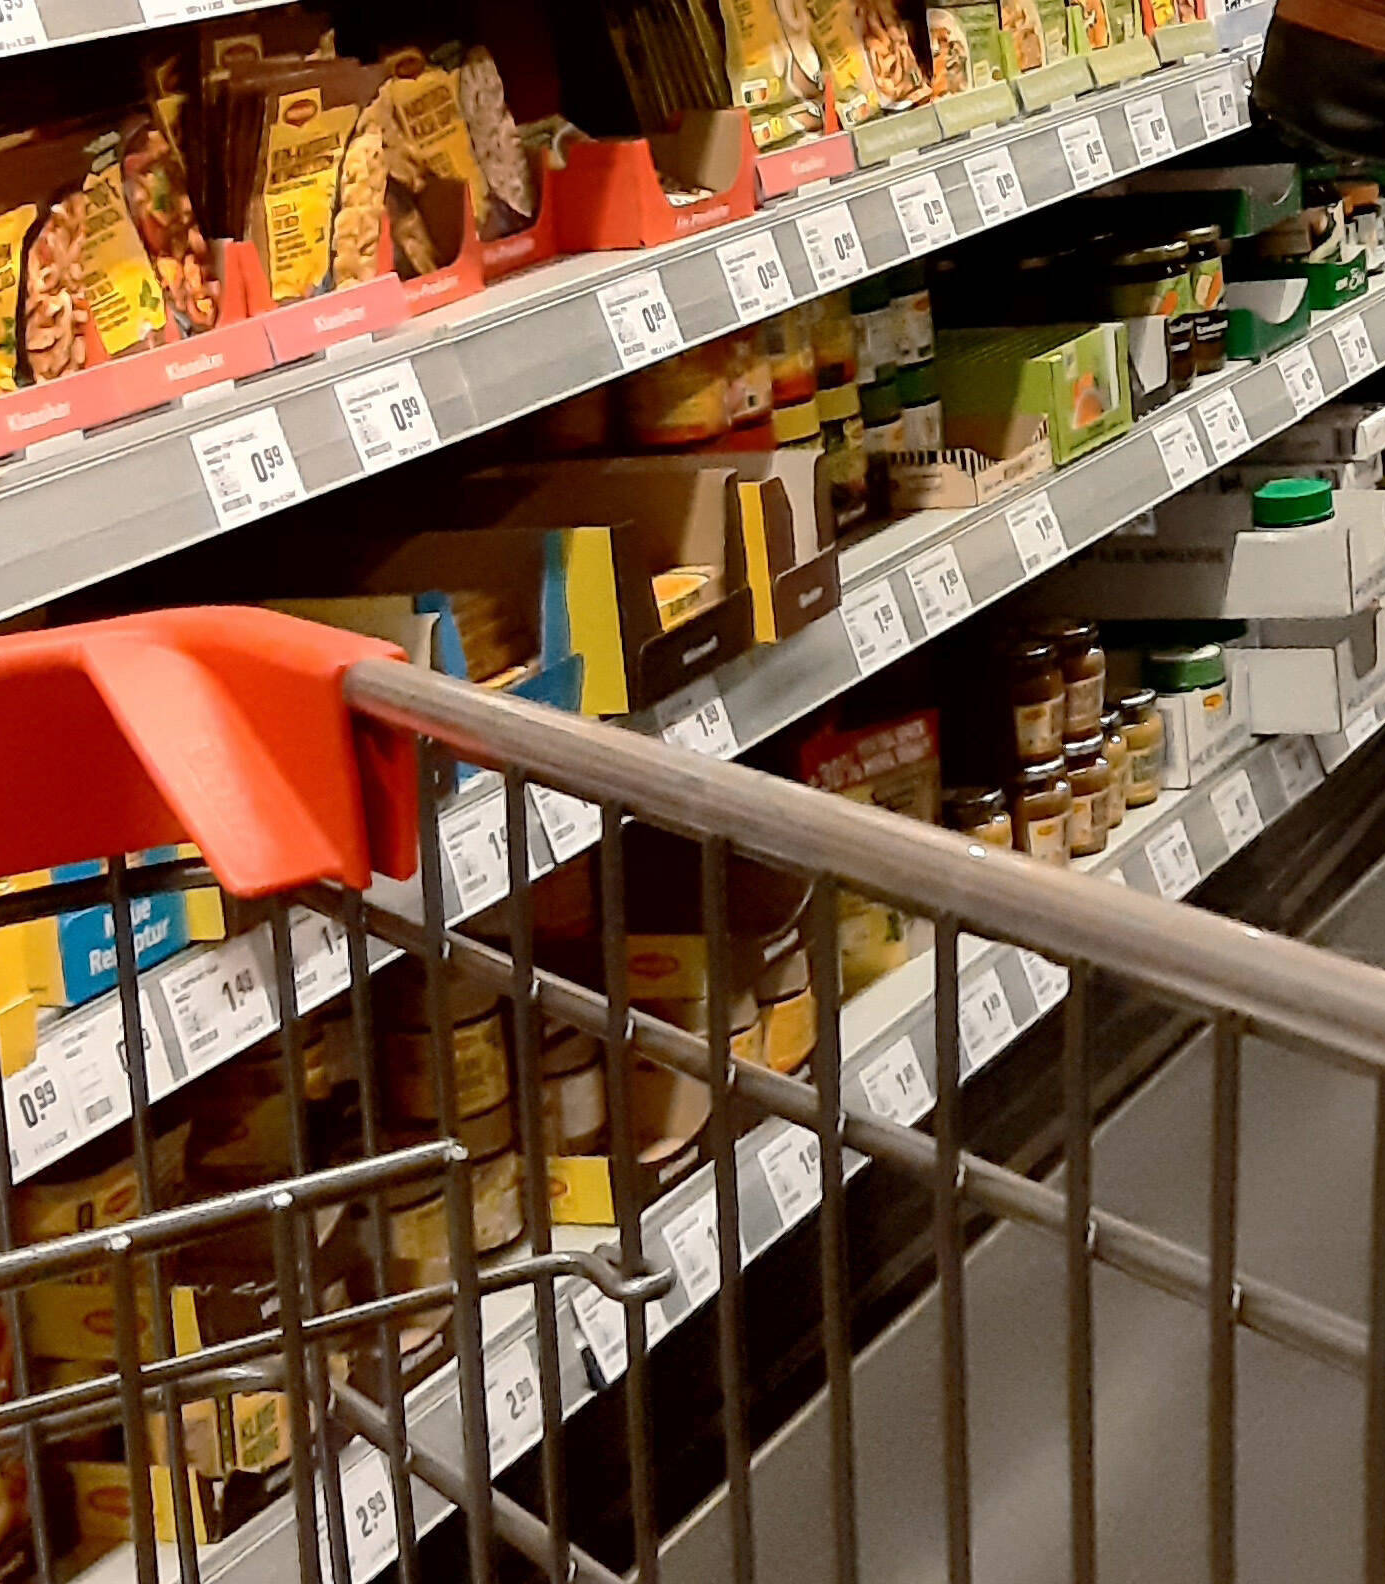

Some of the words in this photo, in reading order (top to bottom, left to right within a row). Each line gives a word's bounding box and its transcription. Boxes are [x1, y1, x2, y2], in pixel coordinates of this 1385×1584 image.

[390, 397, 420, 431] 0.99
[251, 445, 284, 482] 0.99
[19, 1080, 56, 1128] 0.99
